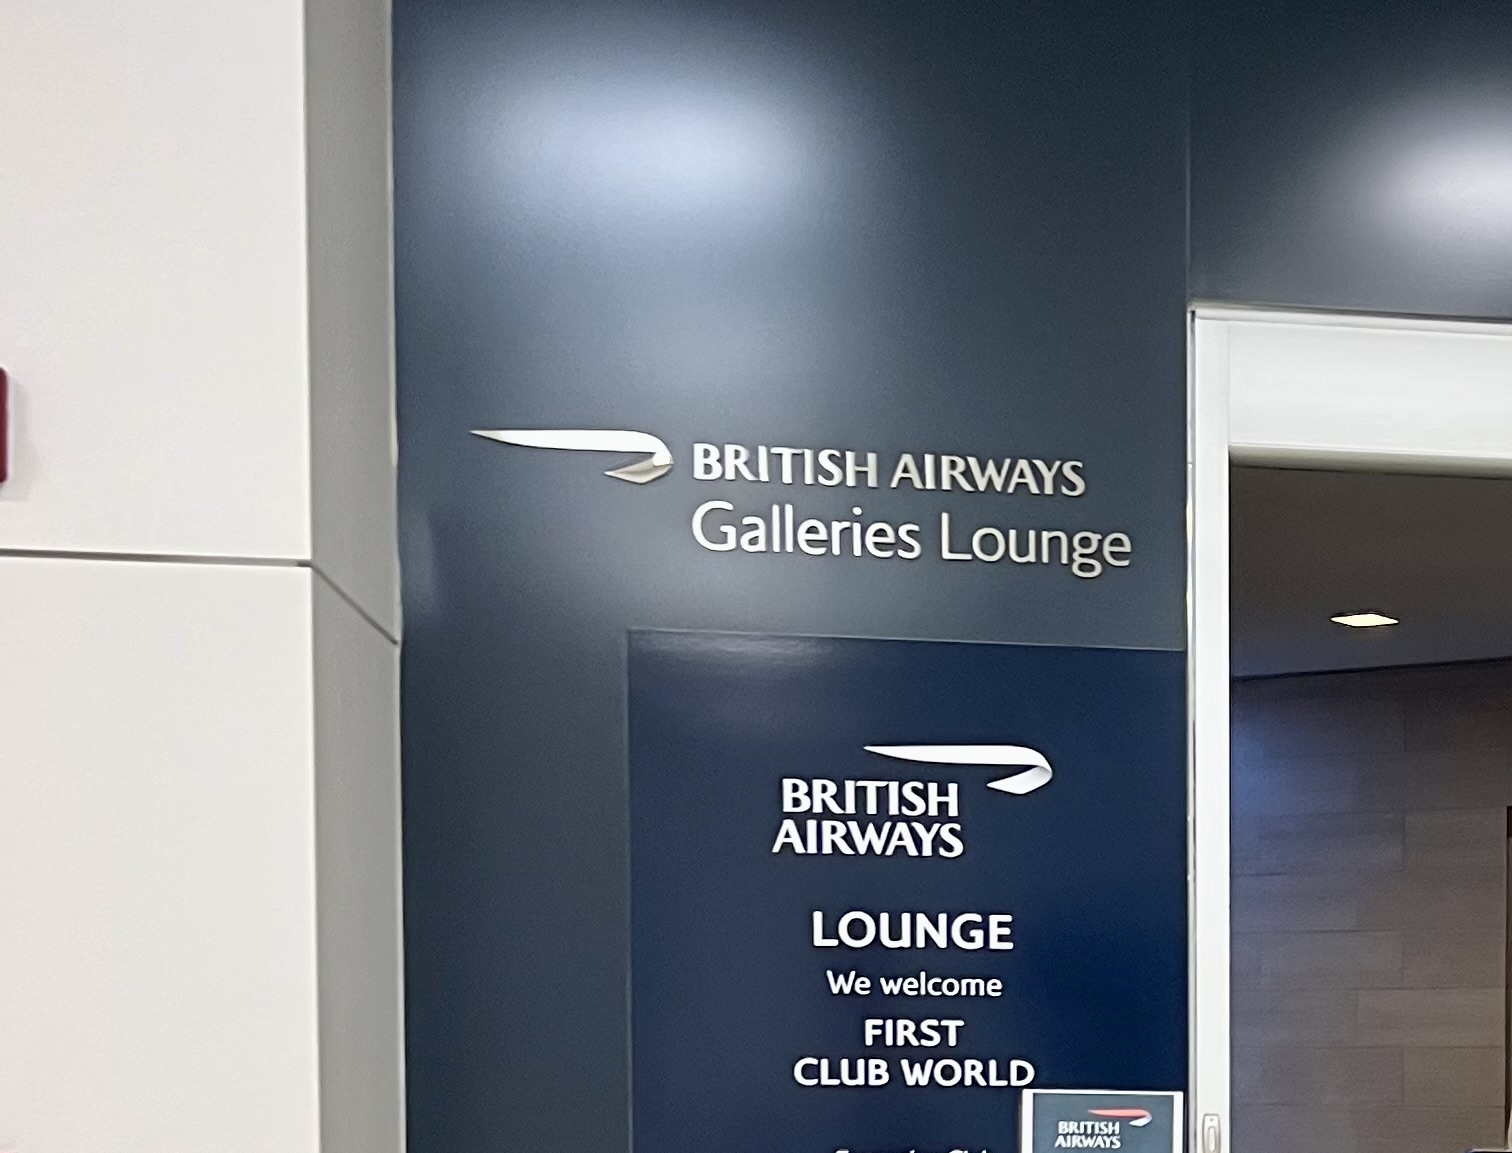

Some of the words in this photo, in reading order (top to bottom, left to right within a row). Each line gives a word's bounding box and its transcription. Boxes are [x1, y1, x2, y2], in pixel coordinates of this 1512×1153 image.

[692, 442, 878, 488] BRITISH
[889, 453, 1086, 496] AIRWAYS
[691, 500, 921, 559] Galleries
[940, 512, 1133, 578] Lounge
[781, 777, 960, 817] BRITISH
[771, 818, 964, 858] AIRWAYS
[812, 910, 1014, 950] LOUNGE
[826, 969, 871, 995] We
[879, 971, 1003, 997] welcome
[864, 1018, 965, 1047] FIRST
[793, 1057, 890, 1086] CLUB
[900, 1058, 1035, 1087] WORLD
[1054, 1135, 1122, 1149] AIRWAYS
[1058, 1120, 1120, 1135] BRITISH
